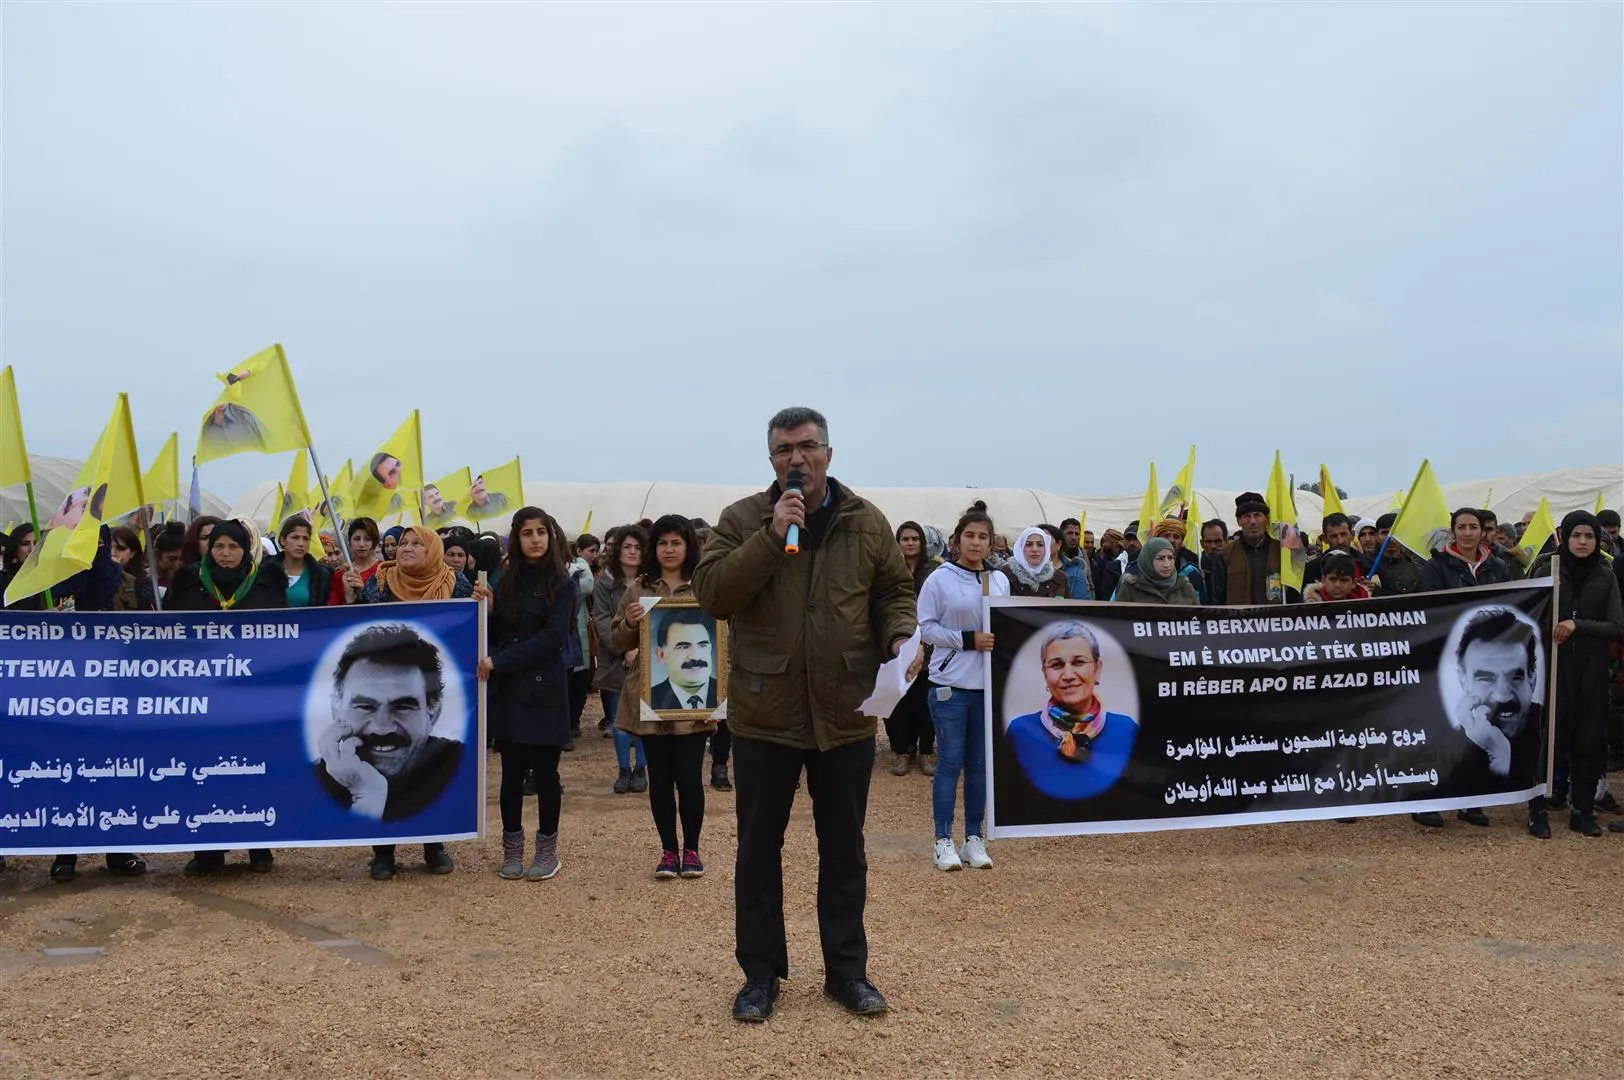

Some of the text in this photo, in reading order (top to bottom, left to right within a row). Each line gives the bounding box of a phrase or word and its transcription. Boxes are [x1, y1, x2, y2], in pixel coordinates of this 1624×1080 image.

[71, 622, 86, 640] Û
[94, 622, 187, 644] FAŞÎZMÊ
[192, 621, 235, 639] TÊK
[241, 624, 299, 639] BIBIN
[1133, 610, 1427, 637] BI RIHÊ BERXWEDANA ZÎNDANAN
[1169, 640, 1410, 666] EM Ê KOMPLOYÊ TÊK BIBIN
[0, 653, 252, 678] TEWA DEMOKRATÎK
[1158, 666, 1420, 697] BI RÊBER APO RE AZAD BIJÎN
[8, 696, 208, 716] MISOGER BIKIN
[1225, 734, 1279, 757] سنفشل
[1282, 730, 1336, 754] السجون
[1338, 727, 1388, 749] مقاومة
[1392, 729, 1426, 747] بروح
[8, 758, 72, 788] وننهي
[77, 757, 144, 782] الفاشية
[149, 757, 187, 781] على
[192, 756, 266, 785] سنقضي
[1384, 768, 1438, 788] وسنحيا
[1241, 781, 1267, 798] عبد
[1271, 773, 1310, 793] القائد
[1314, 777, 1335, 794] مع
[51, 802, 95, 827] الأمة
[99, 805, 137, 831] نهج
[143, 805, 180, 830] على
[186, 804, 276, 833] وسنمضي
